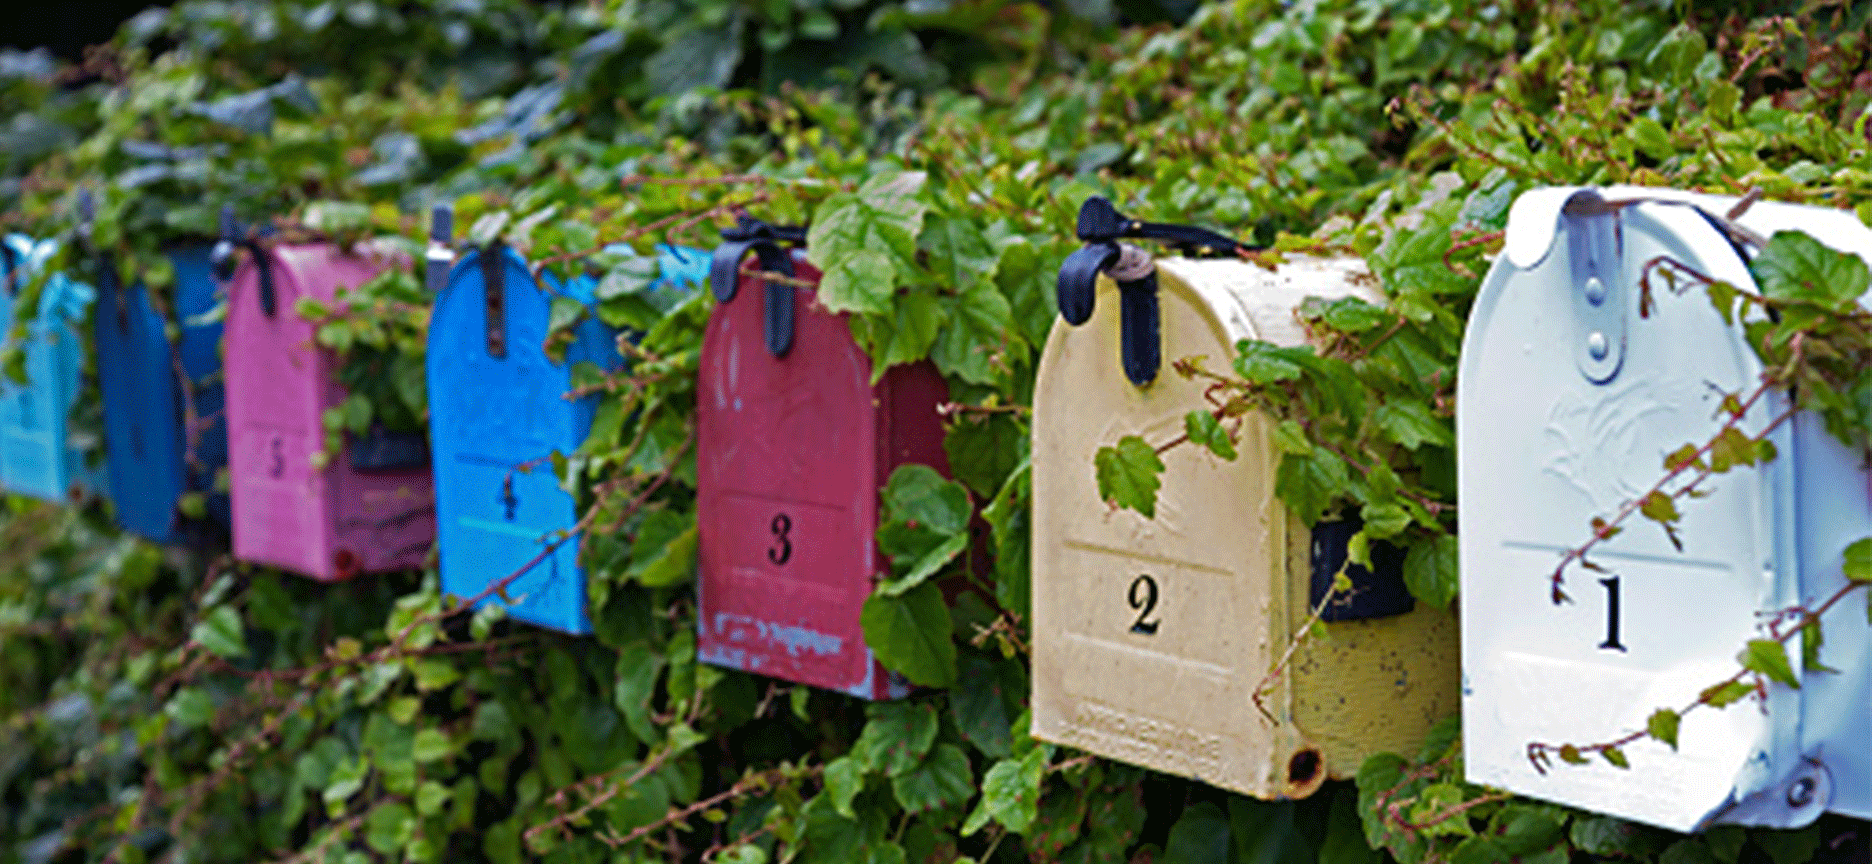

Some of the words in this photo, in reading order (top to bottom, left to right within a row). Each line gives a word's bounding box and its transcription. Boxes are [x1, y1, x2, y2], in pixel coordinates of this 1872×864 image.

[768, 512, 792, 566] 3
[1128, 574, 1161, 635] 2
[1598, 575, 1627, 652] 1
